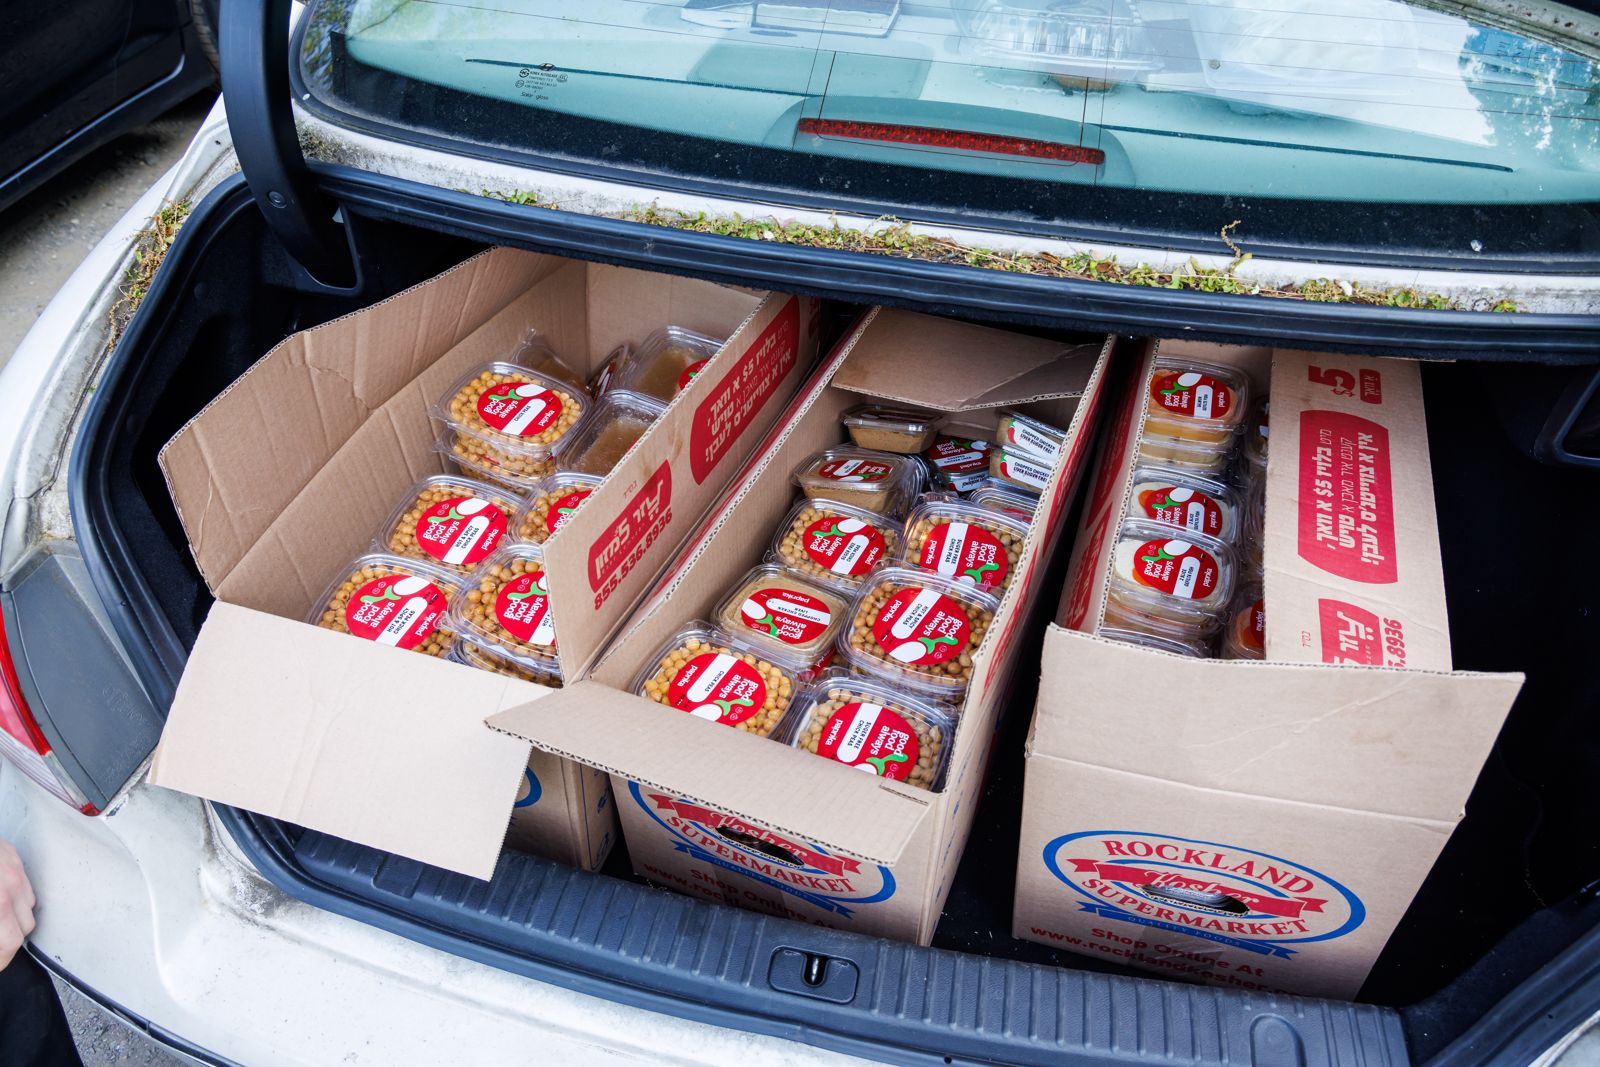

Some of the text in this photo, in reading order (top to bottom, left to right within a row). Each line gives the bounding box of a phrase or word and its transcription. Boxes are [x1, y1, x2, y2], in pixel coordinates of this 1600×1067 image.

[757, 331, 776, 361] בלויז
[771, 365, 778, 379] א
[732, 376, 740, 392] א
[484, 398, 499, 413] good
[492, 403, 506, 415] food
[499, 400, 519, 419] always
[1172, 395, 1180, 407] food
[1179, 391, 1190, 408] always
[514, 411, 524, 422] CHICK
[538, 410, 555, 426] paprika
[711, 402, 734, 436] טויש
[705, 420, 732, 463] לעבן!
[936, 441, 954, 450] good
[1022, 429, 1040, 444] CHOPPED
[1358, 432, 1379, 452] אין
[960, 461, 981, 469] paprika
[1014, 461, 1031, 473] CHOPPED
[1359, 452, 1374, 463] א
[1312, 429, 1338, 550] מיט בלויז $5 א וואך,
[1338, 437, 1359, 548] קענט איר מאכן א טויש
[422, 520, 439, 540] good
[429, 524, 446, 541] food
[439, 521, 460, 544] always
[461, 528, 479, 549] CHICK PEAS
[481, 528, 499, 550] paprika
[810, 534, 824, 550] good
[816, 540, 831, 553] food
[826, 537, 843, 556] always
[926, 540, 937, 564] paprika
[978, 543, 989, 561] food
[1356, 524, 1384, 565] לעבן!
[594, 507, 672, 611] 855.536.8936
[865, 547, 879, 565] paprika
[966, 541, 979, 568] always
[986, 544, 996, 565] good
[1144, 560, 1154, 576] good
[1152, 564, 1162, 578] food
[1162, 561, 1174, 581] always
[1203, 568, 1212, 587] paprika
[503, 597, 520, 619] good
[782, 592, 810, 603] paprika
[353, 600, 373, 622] good
[360, 604, 380, 624] food
[370, 602, 395, 628] always
[387, 623, 395, 632] HOT
[399, 608, 409, 620] SPICY
[512, 602, 530, 620] food
[523, 597, 544, 624] always
[882, 600, 902, 622] paprika
[903, 603, 922, 625] CHICK PEAS
[393, 610, 415, 634] CHICK PEAS
[415, 612, 437, 636] paprika
[775, 616, 806, 629] always
[782, 625, 803, 636] food
[923, 611, 945, 636] always
[937, 615, 955, 634] food
[945, 618, 963, 640] good
[776, 629, 802, 639] good
[677, 665, 698, 687] paprika
[705, 670, 725, 692] CHICK PEAS
[719, 674, 741, 699] always
[734, 678, 750, 696] food
[741, 680, 759, 702] good
[825, 719, 843, 745] paprika
[848, 720, 865, 746] CHICK PEAS
[854, 736, 864, 749] FREE
[870, 725, 890, 755] always
[885, 729, 900, 751] food
[893, 731, 909, 757] good
[666, 815, 856, 893] SUPERMARKET
[1102, 840, 1314, 893] ROCKLAND
[690, 868, 739, 896] Shop
[743, 889, 808, 922] Online
[1082, 878, 1310, 935] SUPERMARKET
[1092, 928, 1265, 978] Shop Online At
